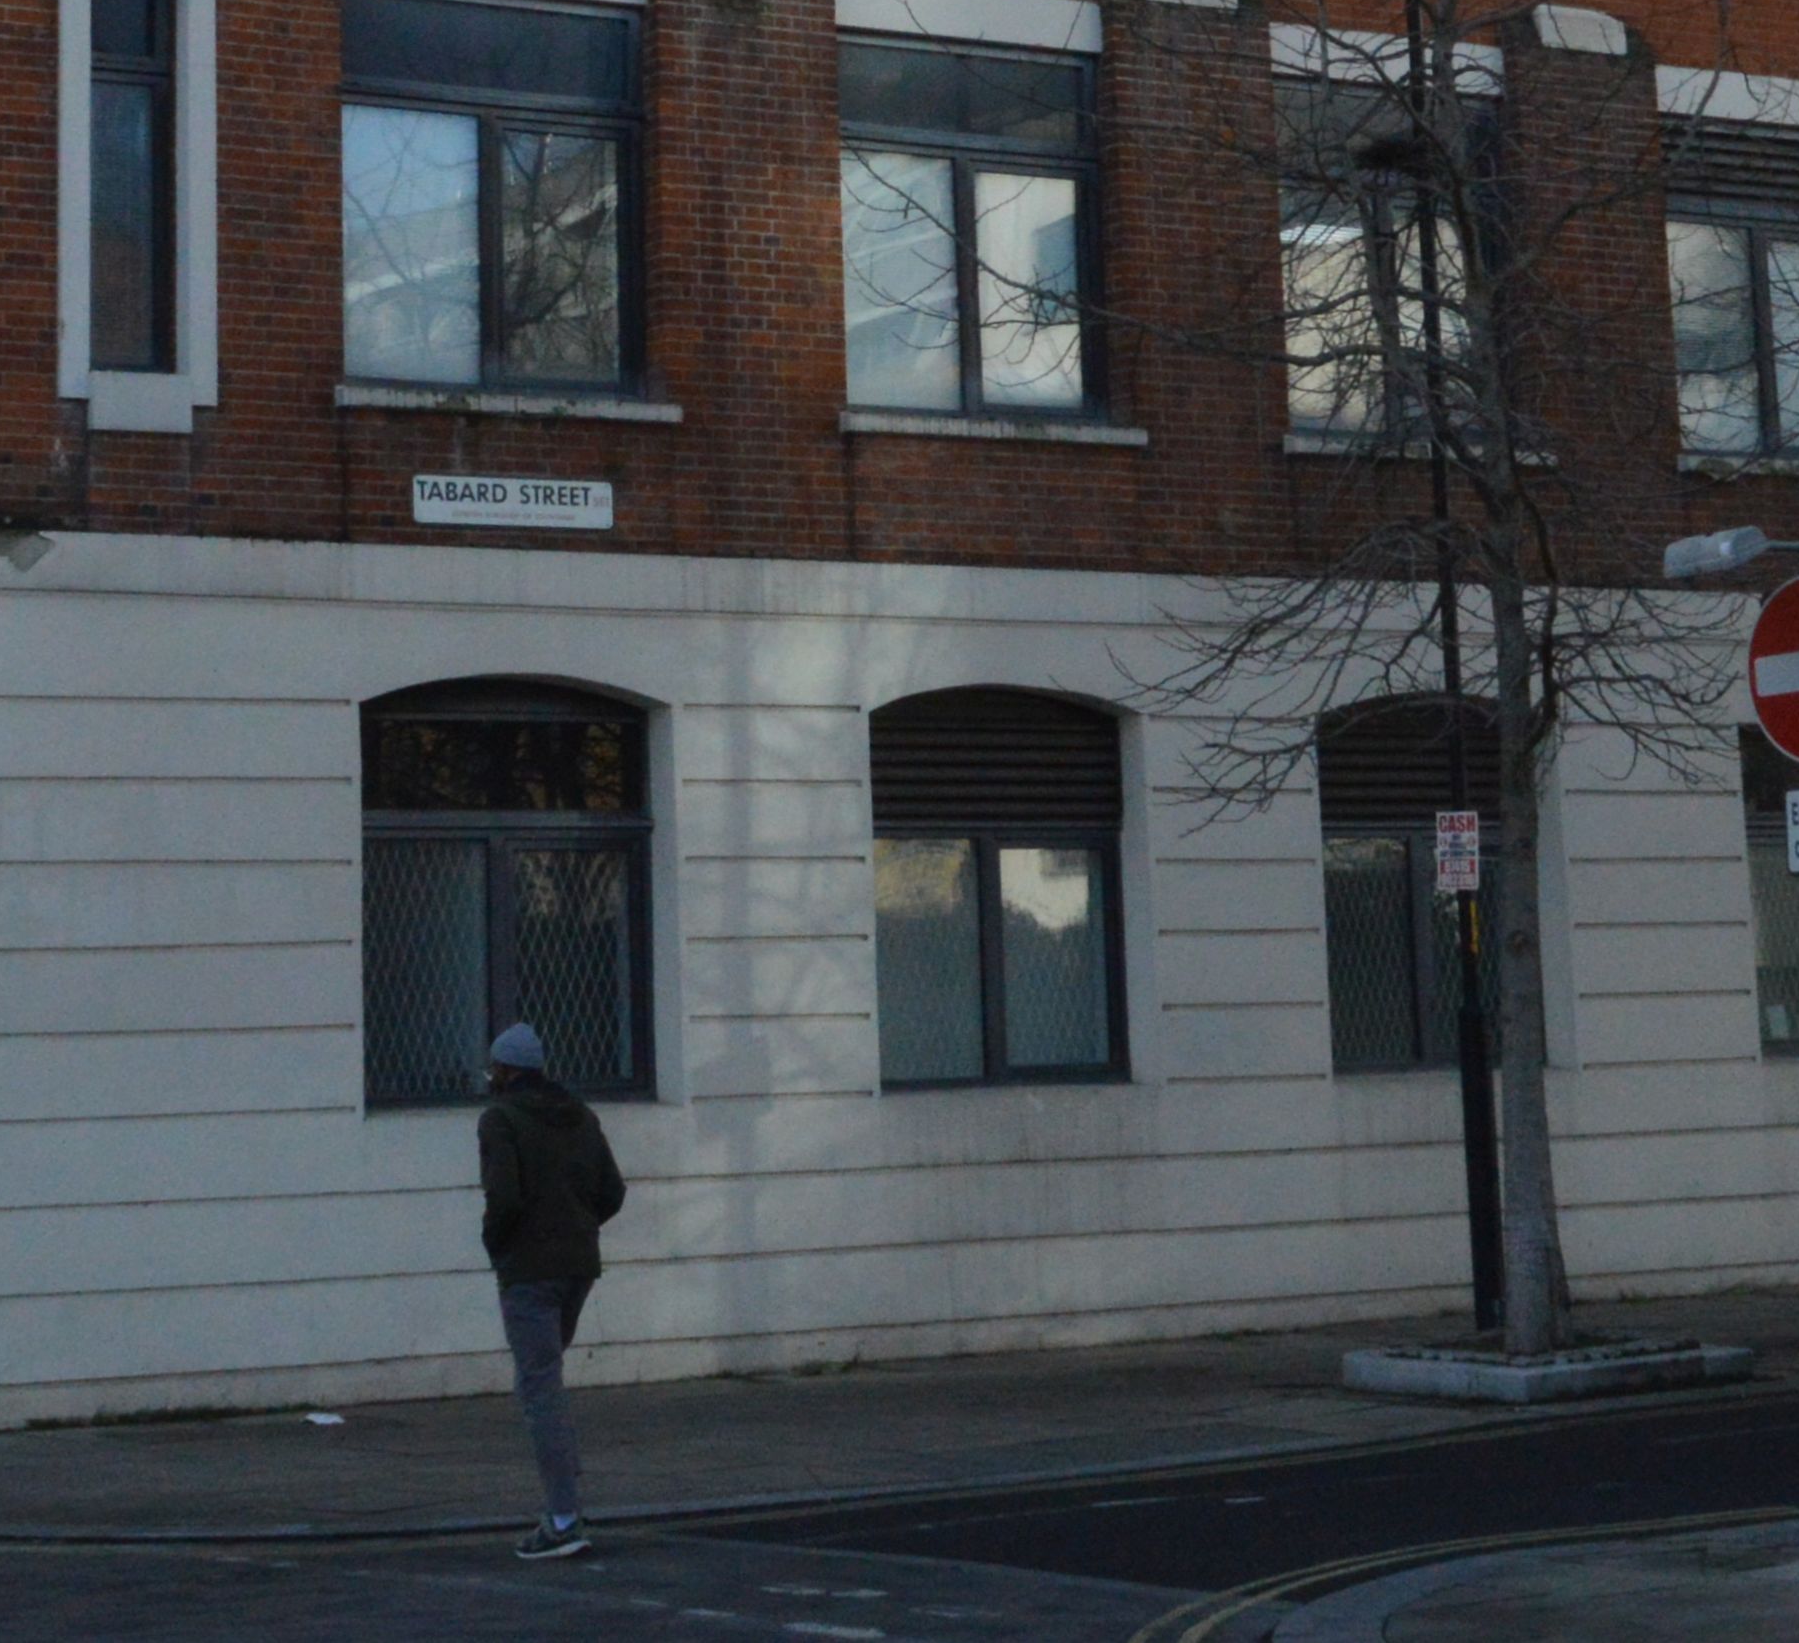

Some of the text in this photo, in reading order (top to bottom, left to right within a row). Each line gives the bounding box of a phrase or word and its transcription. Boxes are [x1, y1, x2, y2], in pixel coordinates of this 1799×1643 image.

[416, 479, 507, 504] TABARD
[519, 483, 592, 507] STREET
[1438, 814, 1476, 834] CASH
